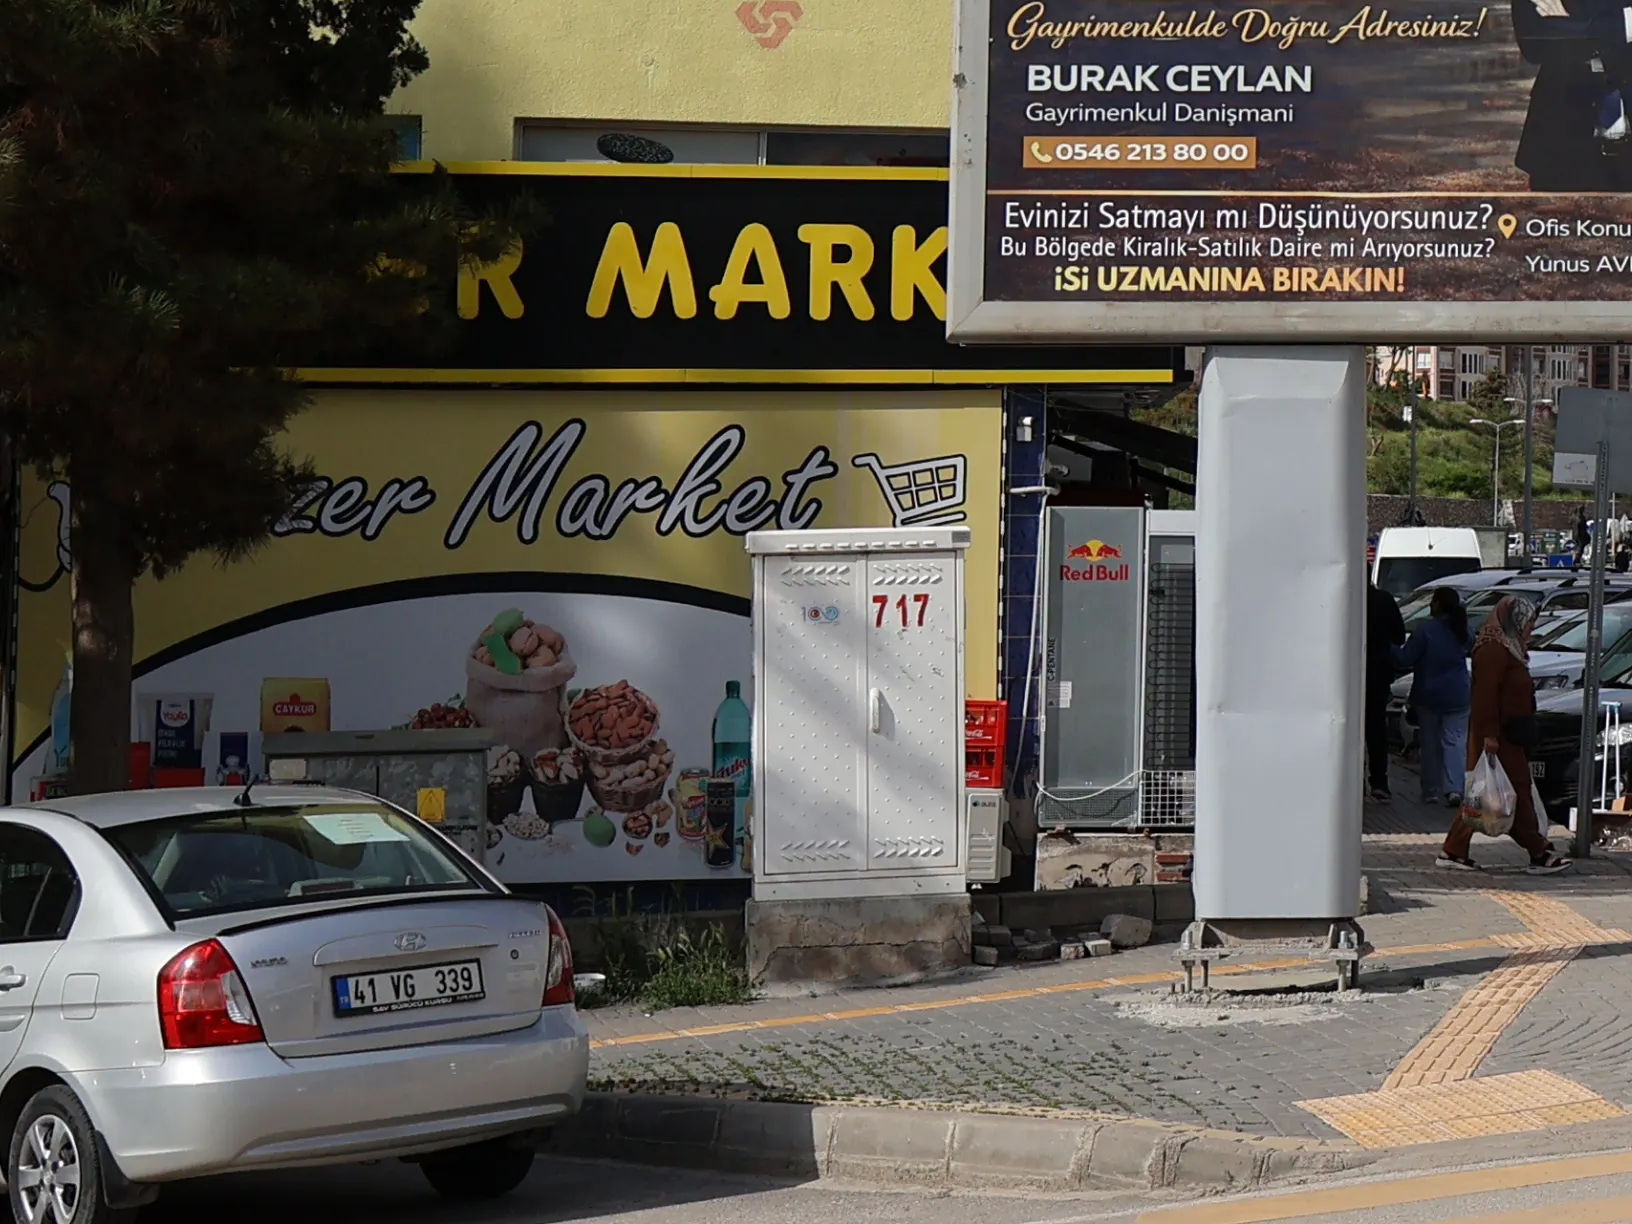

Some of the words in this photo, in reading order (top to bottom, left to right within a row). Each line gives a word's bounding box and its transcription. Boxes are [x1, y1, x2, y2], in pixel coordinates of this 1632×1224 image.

[1007, 1, 1229, 50] Gayrimenkulde
[1232, 8, 1331, 48] Doğru
[1328, 5, 1488, 44] Adresiniz!
[1027, 65, 1160, 92] BURAK
[1165, 65, 1312, 93] CEYLAN
[1026, 103, 1168, 128] Gayrimenkul
[1175, 102, 1295, 126] Danişmani
[1055, 143, 1121, 162] 0546
[1126, 143, 1167, 162] 213
[1173, 143, 1207, 162] 80
[1212, 143, 1249, 162] 00
[1005, 202, 1089, 229] Evinizi
[1099, 202, 1205, 235] Satmayı
[1216, 207, 1247, 229] mı
[1258, 202, 1493, 237] Düşünüyorsunuz?
[1526, 219, 1569, 237] Ofis
[1001, 237, 1026, 257] Bu
[1036, 236, 1116, 262] Bölgede
[1124, 236, 1262, 258] Kiralık-Satılık
[1270, 236, 1322, 257] Daire
[1330, 237, 1355, 257] mi
[1362, 237, 1496, 262] Arıyorsunuz?
[1526, 256, 1590, 273] Yunus
[1098, 266, 1266, 292] UZMANINA
[1274, 266, 1405, 293] BIRAKIN!
[446, 417, 836, 550] Market
[1060, 564, 1093, 581] Red
[1096, 564, 1130, 581] Bull
[872, 593, 930, 628] 717
[354, 977, 377, 1005] 41
[390, 973, 416, 1000] VG
[434, 966, 474, 995] 339
